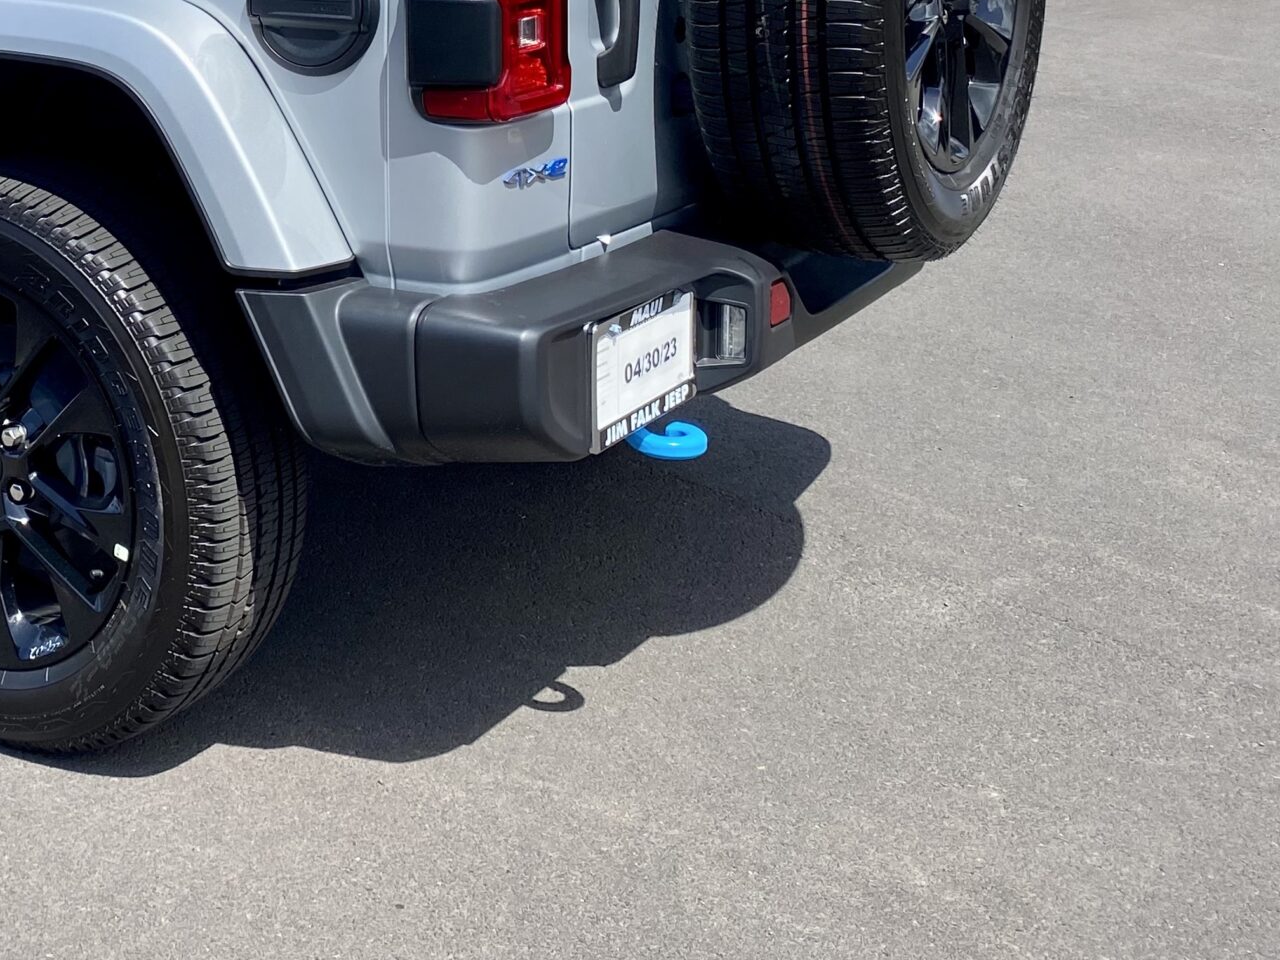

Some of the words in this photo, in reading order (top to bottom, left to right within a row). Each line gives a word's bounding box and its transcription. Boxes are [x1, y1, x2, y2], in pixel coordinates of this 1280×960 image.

[630, 297, 664, 327] MAUI
[624, 337, 678, 384] 04/30/23
[605, 419, 628, 446] JIM
[631, 401, 661, 431] FALK
[663, 383, 689, 412] JEEP
